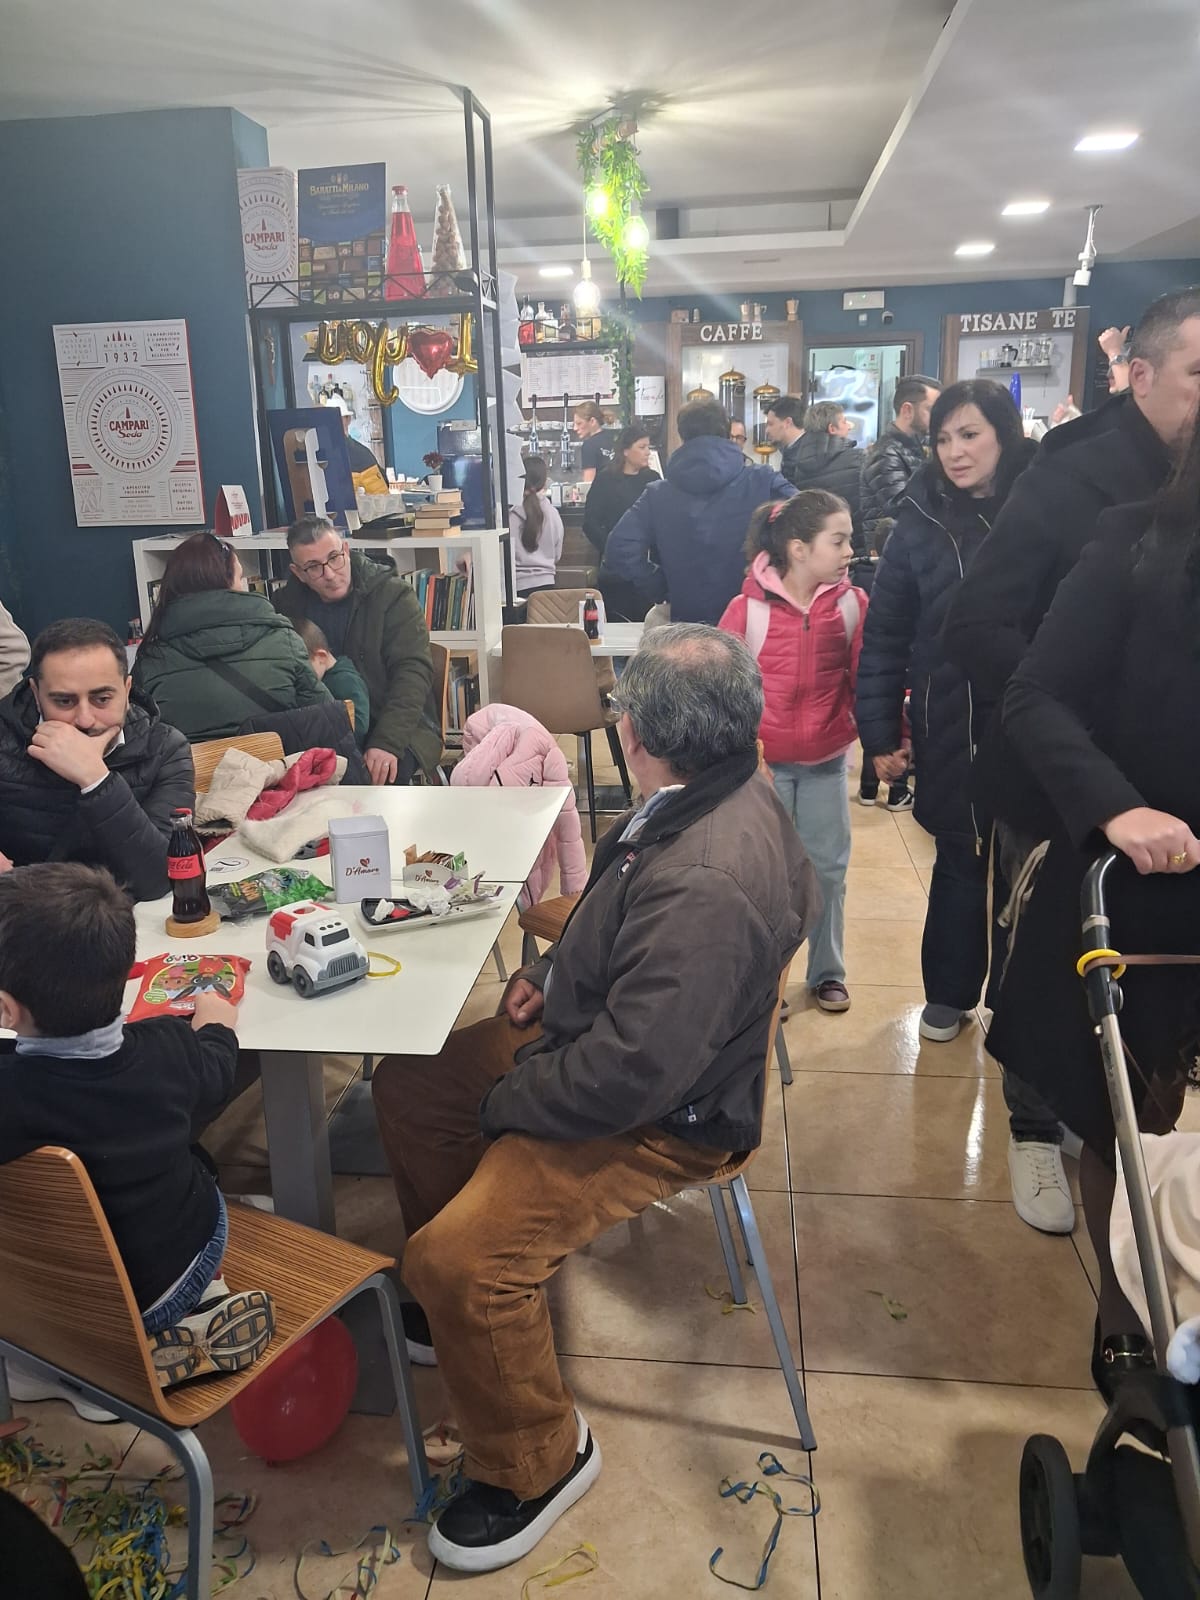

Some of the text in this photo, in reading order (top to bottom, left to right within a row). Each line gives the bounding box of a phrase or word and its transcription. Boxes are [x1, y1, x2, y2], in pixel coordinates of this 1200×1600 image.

[244, 231, 285, 244] CAMPARI
[253, 242, 279, 252] Soda
[960, 309, 1077, 332] TISANE TE
[104, 352, 138, 363] 1932
[109, 420, 149, 431] CAMPARI
[118, 430, 143, 438] Soda
[345, 866, 380, 877] D'Amore
[415, 873, 440, 884] D'Amore
